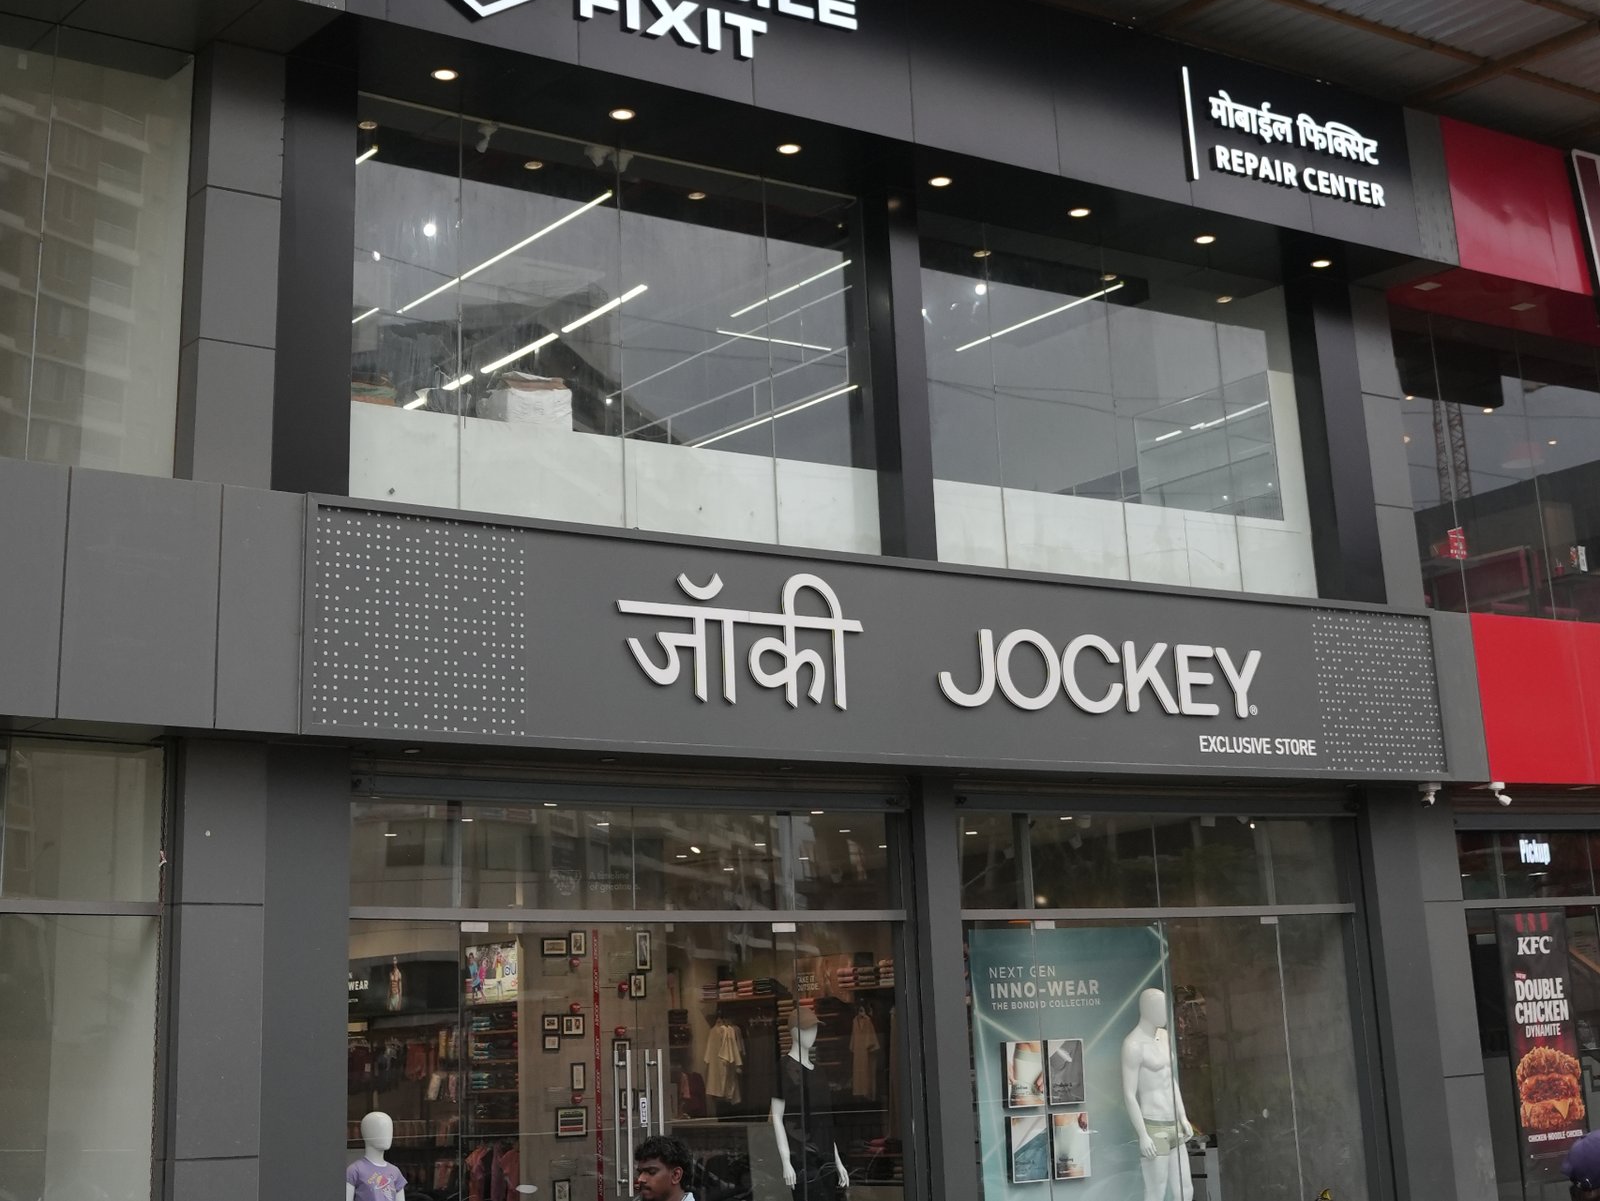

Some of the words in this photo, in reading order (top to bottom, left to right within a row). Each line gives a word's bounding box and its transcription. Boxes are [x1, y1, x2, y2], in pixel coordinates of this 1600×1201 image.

[1208, 90, 1293, 144] मोबाईल
[1296, 113, 1380, 166] फिक्सिट
[1214, 144, 1299, 187] REPAIR
[1302, 167, 1386, 207] CENTER
[616, 572, 864, 711] जॉकी
[938, 627, 1262, 719] JOCKEY
[1198, 735, 1273, 755] EXCLUSIVE
[1274, 738, 1318, 757] STORE
[1518, 838, 1552, 866] Pickup
[1517, 936, 1552, 956] KFC
[988, 966, 1024, 979] NEXT
[1029, 965, 1056, 978] GEN
[989, 979, 1099, 999] INNO-WEAR
[1514, 978, 1565, 1002] DOUBLE
[992, 1002, 1008, 1010] THE
[1049, 998, 1101, 1008] COLLECTION
[1514, 999, 1570, 1025] CHICKEN
[1525, 1023, 1562, 1038] DYNAMITE
